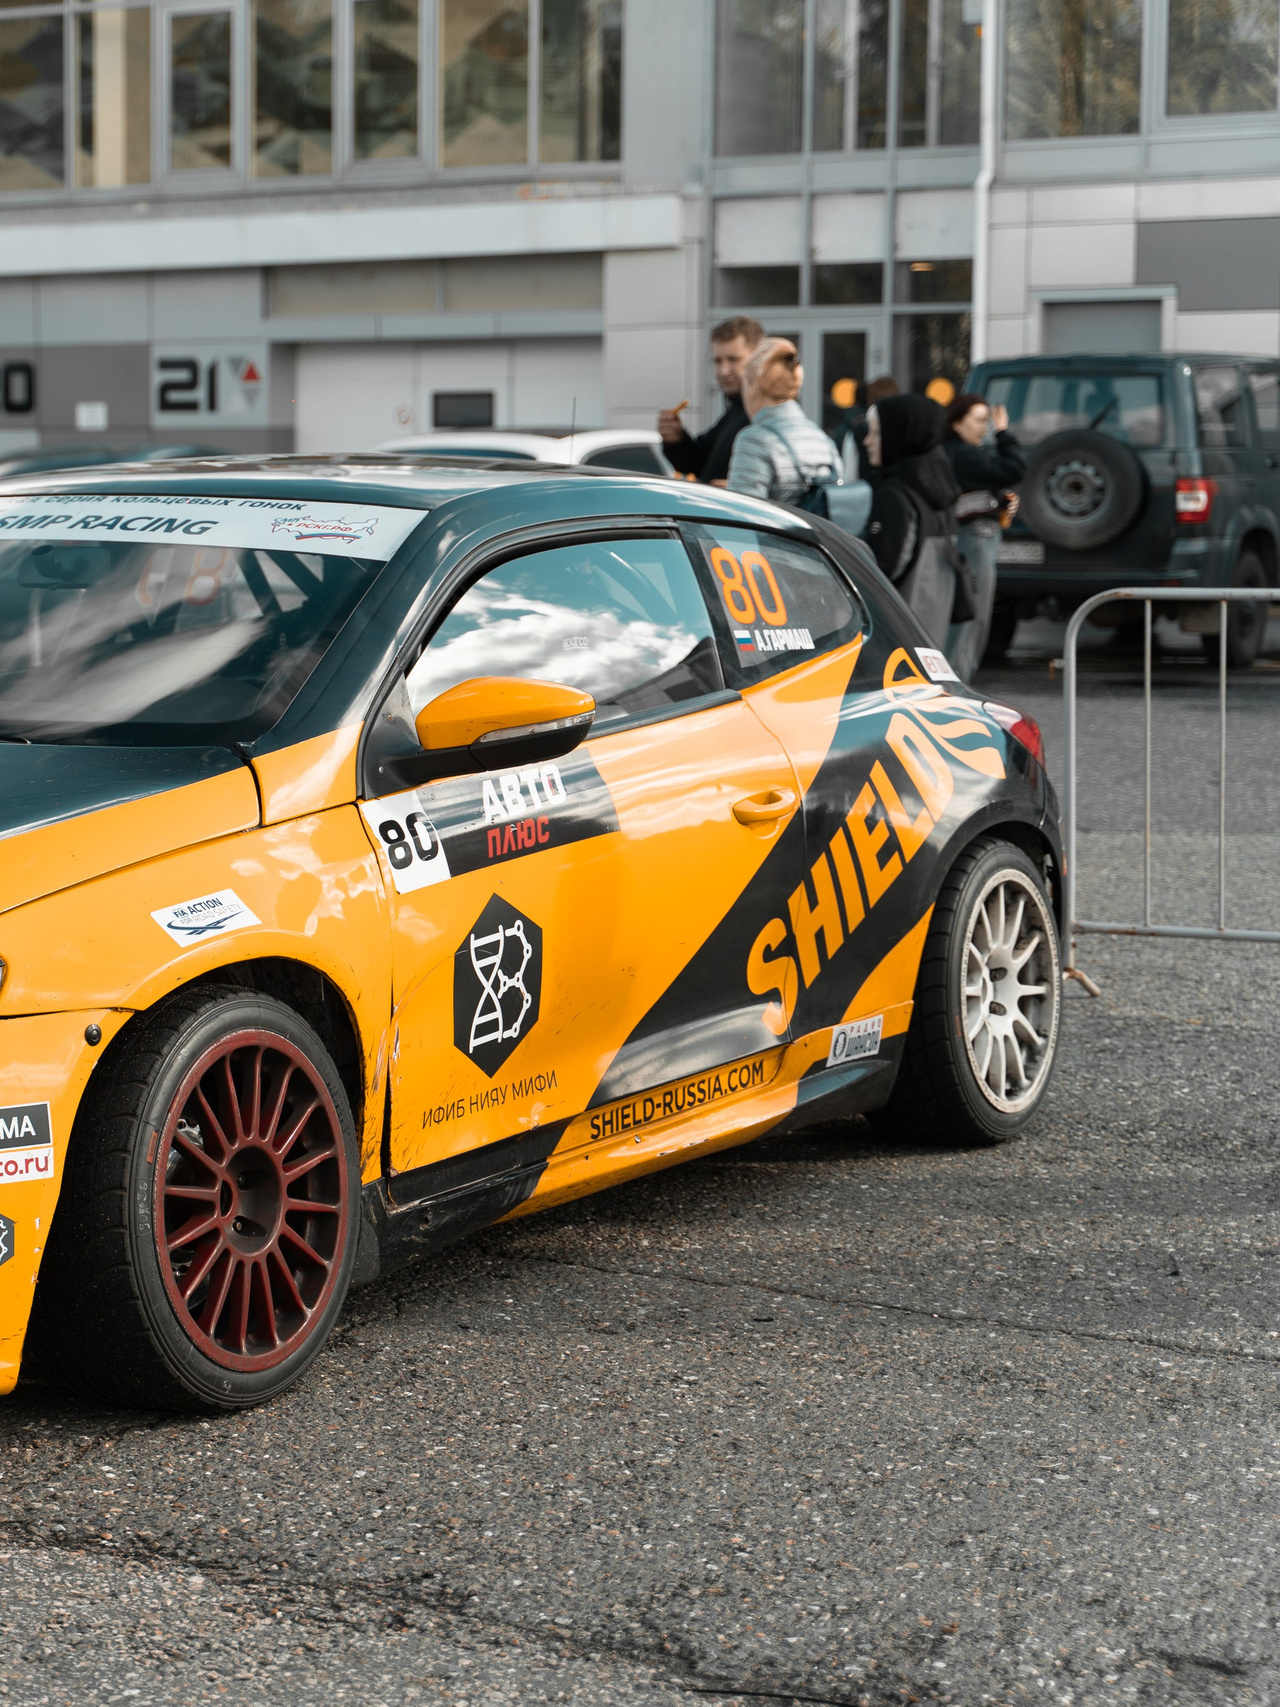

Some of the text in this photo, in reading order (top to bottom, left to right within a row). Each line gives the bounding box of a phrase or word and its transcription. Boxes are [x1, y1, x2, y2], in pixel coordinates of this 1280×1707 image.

[159, 360, 218, 412] 21
[67, 514, 220, 535] RACING
[710, 546, 788, 626] 80
[754, 628, 816, 651] А.ГАРМАШ
[482, 763, 567, 823] АВТО
[378, 811, 439, 870] 80
[487, 815, 551, 859] ПЛЮС
[746, 711, 955, 1036] SHIELD
[173, 897, 223, 919] FIA ACTION
[421, 1069, 558, 1130] ИФИБ НИЯУ МИФИ
[590, 1059, 765, 1141] SHIELD-RUSSIA.COM
